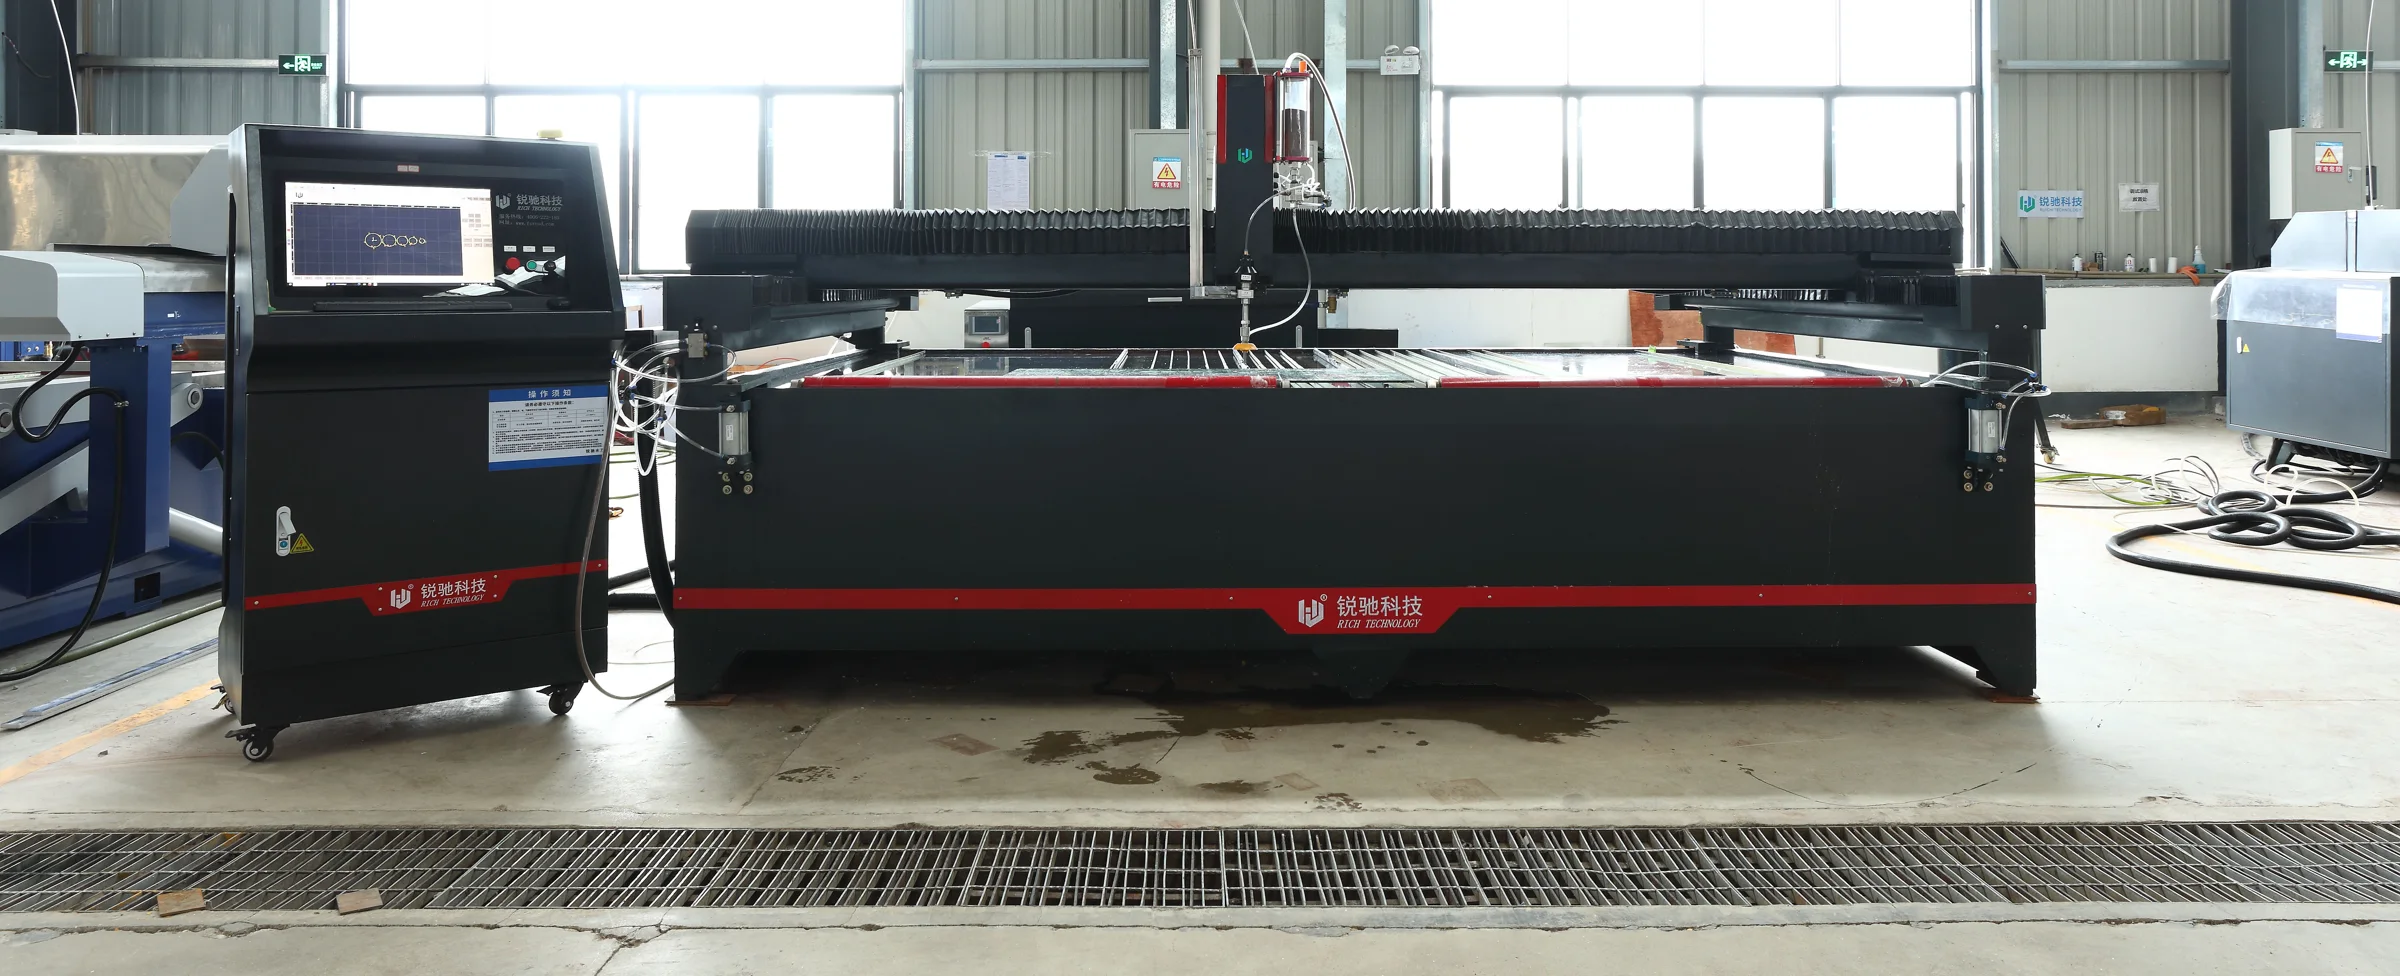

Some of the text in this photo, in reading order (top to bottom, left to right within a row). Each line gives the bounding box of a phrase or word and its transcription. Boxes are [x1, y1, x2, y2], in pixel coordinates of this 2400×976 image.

[516, 194, 563, 206] 锐驰科技
[2039, 196, 2083, 207] 锐驰科技
[528, 389, 572, 398] 操作须知
[420, 578, 486, 599] 锐驰科技
[421, 594, 485, 607] RICH TECHNOLOGY
[1336, 595, 1423, 616] 锐驰科技
[1337, 619, 1420, 628] RICH TECHNOLOGY
